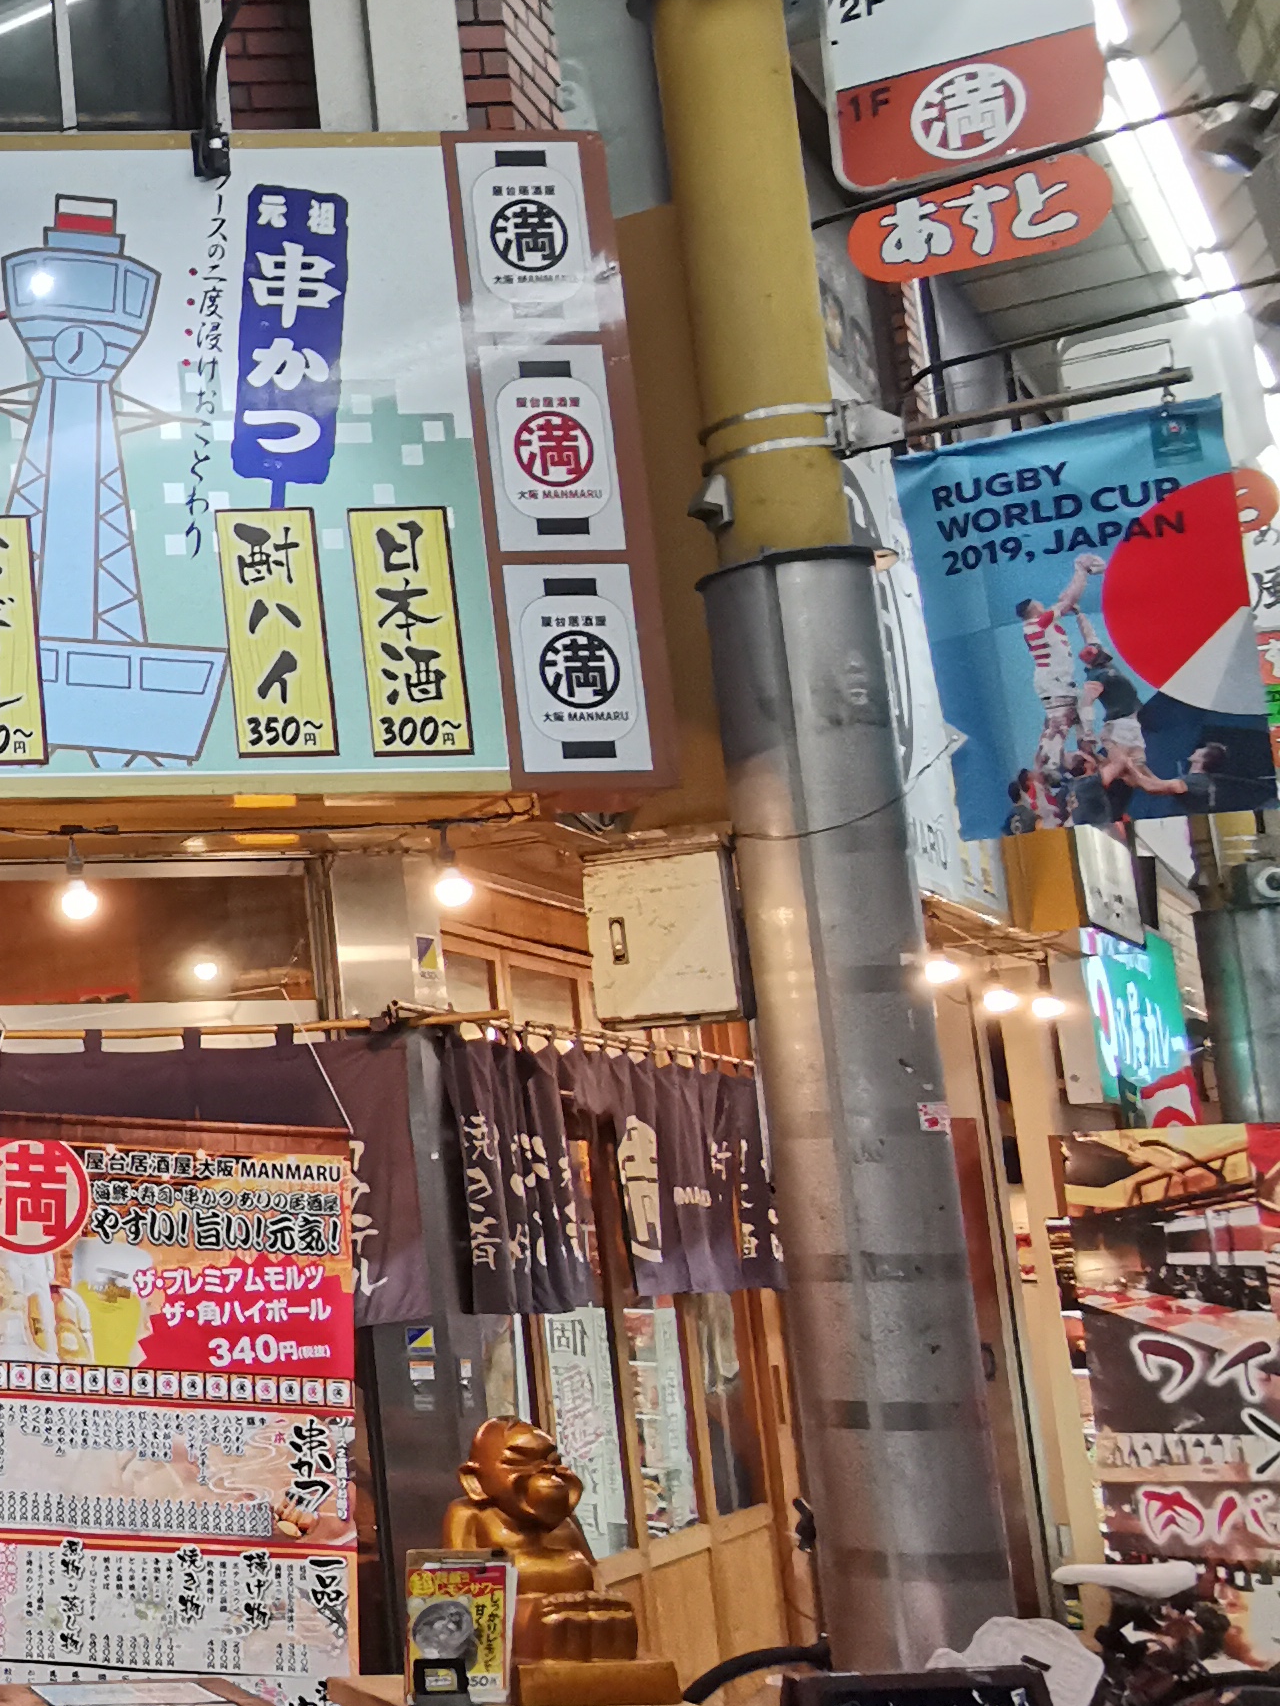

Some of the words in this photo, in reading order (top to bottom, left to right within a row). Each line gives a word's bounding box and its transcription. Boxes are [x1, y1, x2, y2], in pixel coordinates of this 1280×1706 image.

[848, 88, 892, 123] 1F
[910, 63, 1026, 159] 満
[257, 192, 337, 236] 元祖
[490, 198, 568, 273] 満
[880, 172, 1080, 266] あすと
[243, 239, 344, 457] 串かつ
[514, 410, 593, 487] 満
[542, 489, 603, 501] MANMARU
[931, 461, 1068, 513] RUGBY
[935, 490, 1085, 544] WORLD
[1090, 476, 1181, 519] CUP
[1042, 510, 1186, 561] JAPAN
[238, 526, 301, 705] 酎ハイ
[375, 526, 445, 705] 日本酒
[539, 631, 620, 710] 満
[567, 711, 630, 724] MANMARU
[86, 1150, 192, 1177] 屋台居酒屋
[199, 1157, 234, 1178] 大阪
[240, 1160, 341, 1182] MANMARU
[208, 1333, 298, 1367] 340円
[177, 1548, 200, 1617] 焼き物
[243, 1552, 269, 1626] 揚げ物
[309, 1559, 345, 1605] 一品
